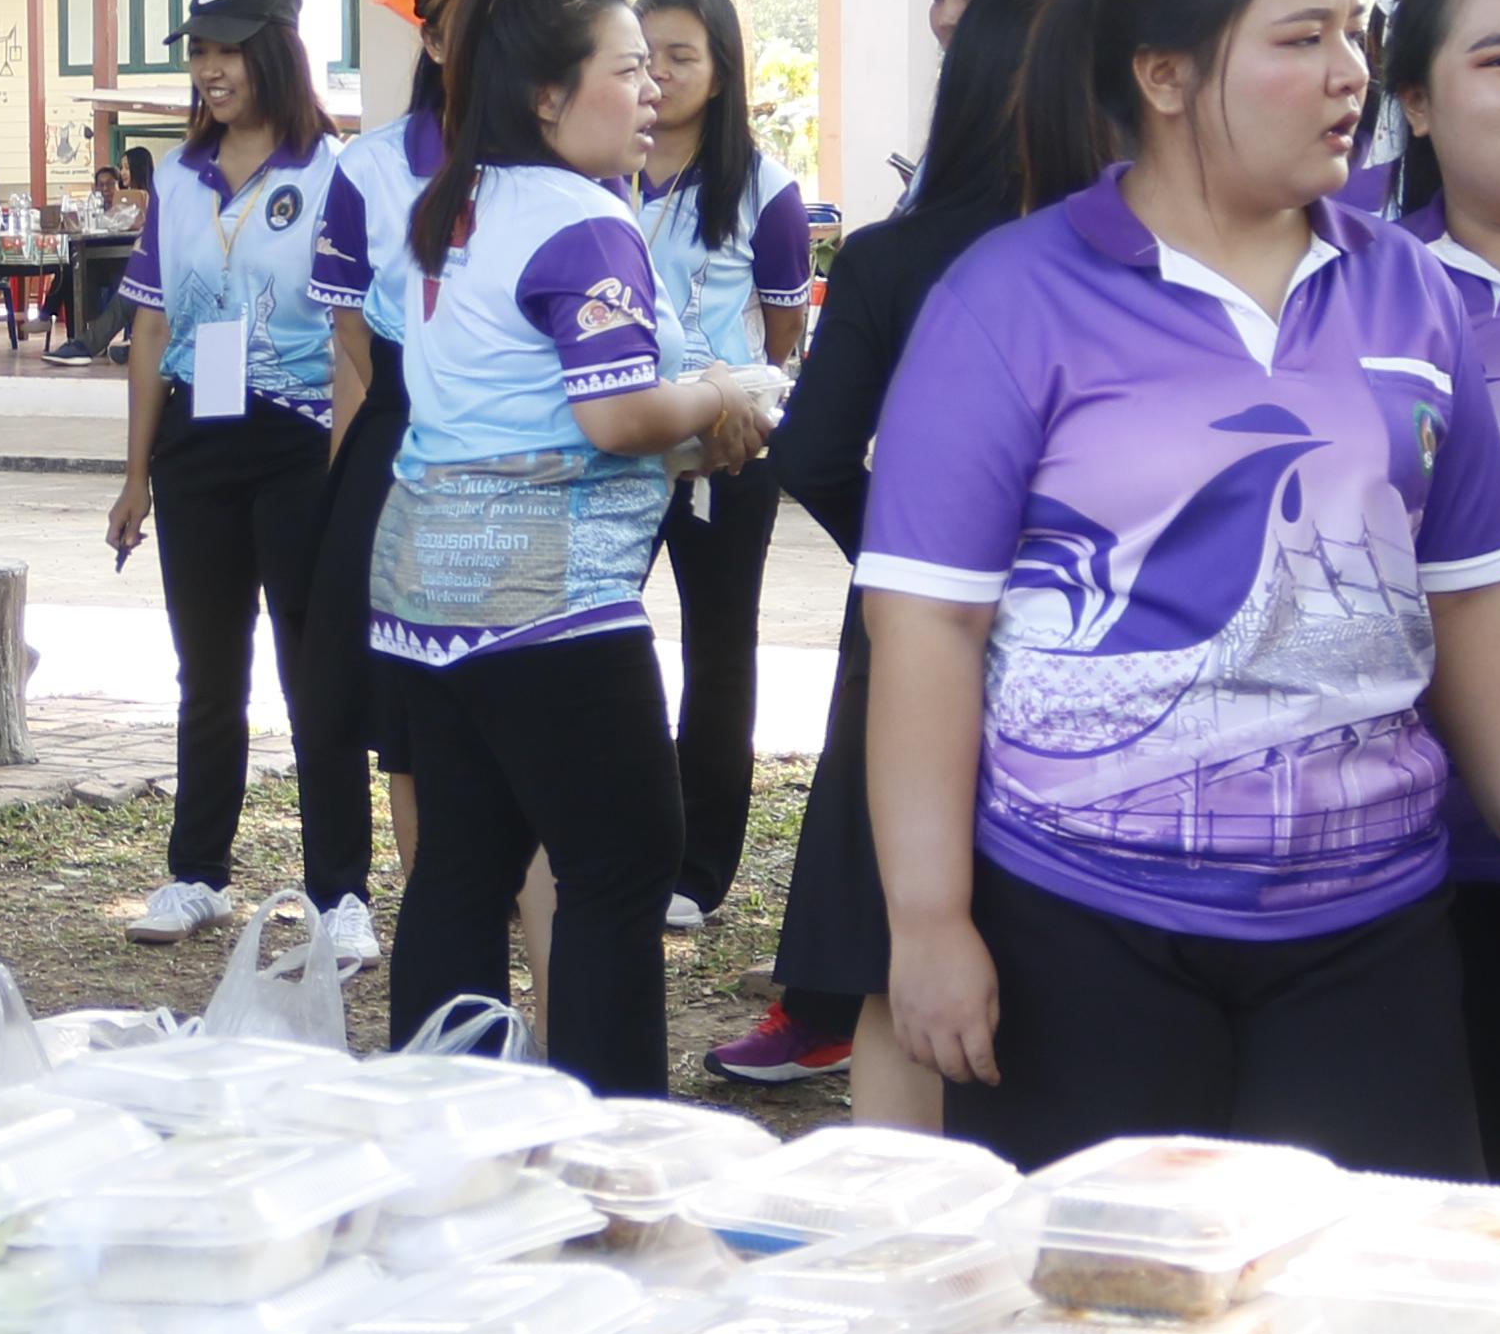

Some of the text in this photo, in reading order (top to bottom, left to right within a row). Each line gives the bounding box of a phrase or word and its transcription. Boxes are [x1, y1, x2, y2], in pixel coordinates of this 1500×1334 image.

[490, 503, 560, 518] province
[448, 551, 505, 569] Heritage
[425, 588, 484, 603] Welcome
